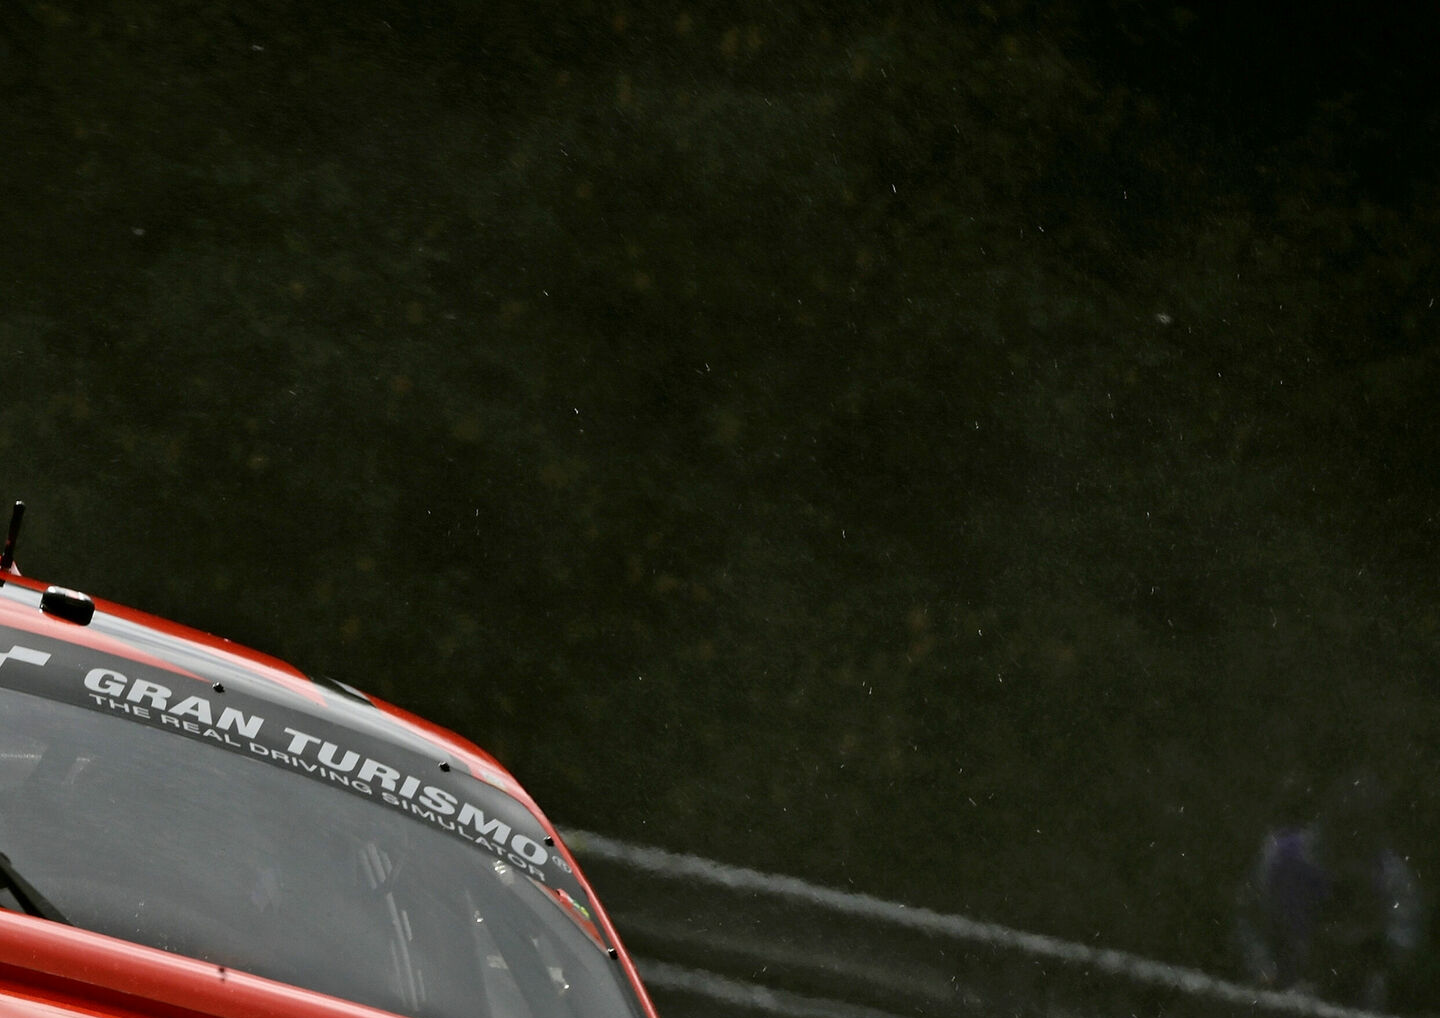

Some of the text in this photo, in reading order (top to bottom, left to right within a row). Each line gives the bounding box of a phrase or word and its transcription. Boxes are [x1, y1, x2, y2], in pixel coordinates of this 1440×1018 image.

[83, 667, 548, 866] GRAN TURISMO
[89, 693, 546, 882] THE REAL DRIVING SIMULATOR
